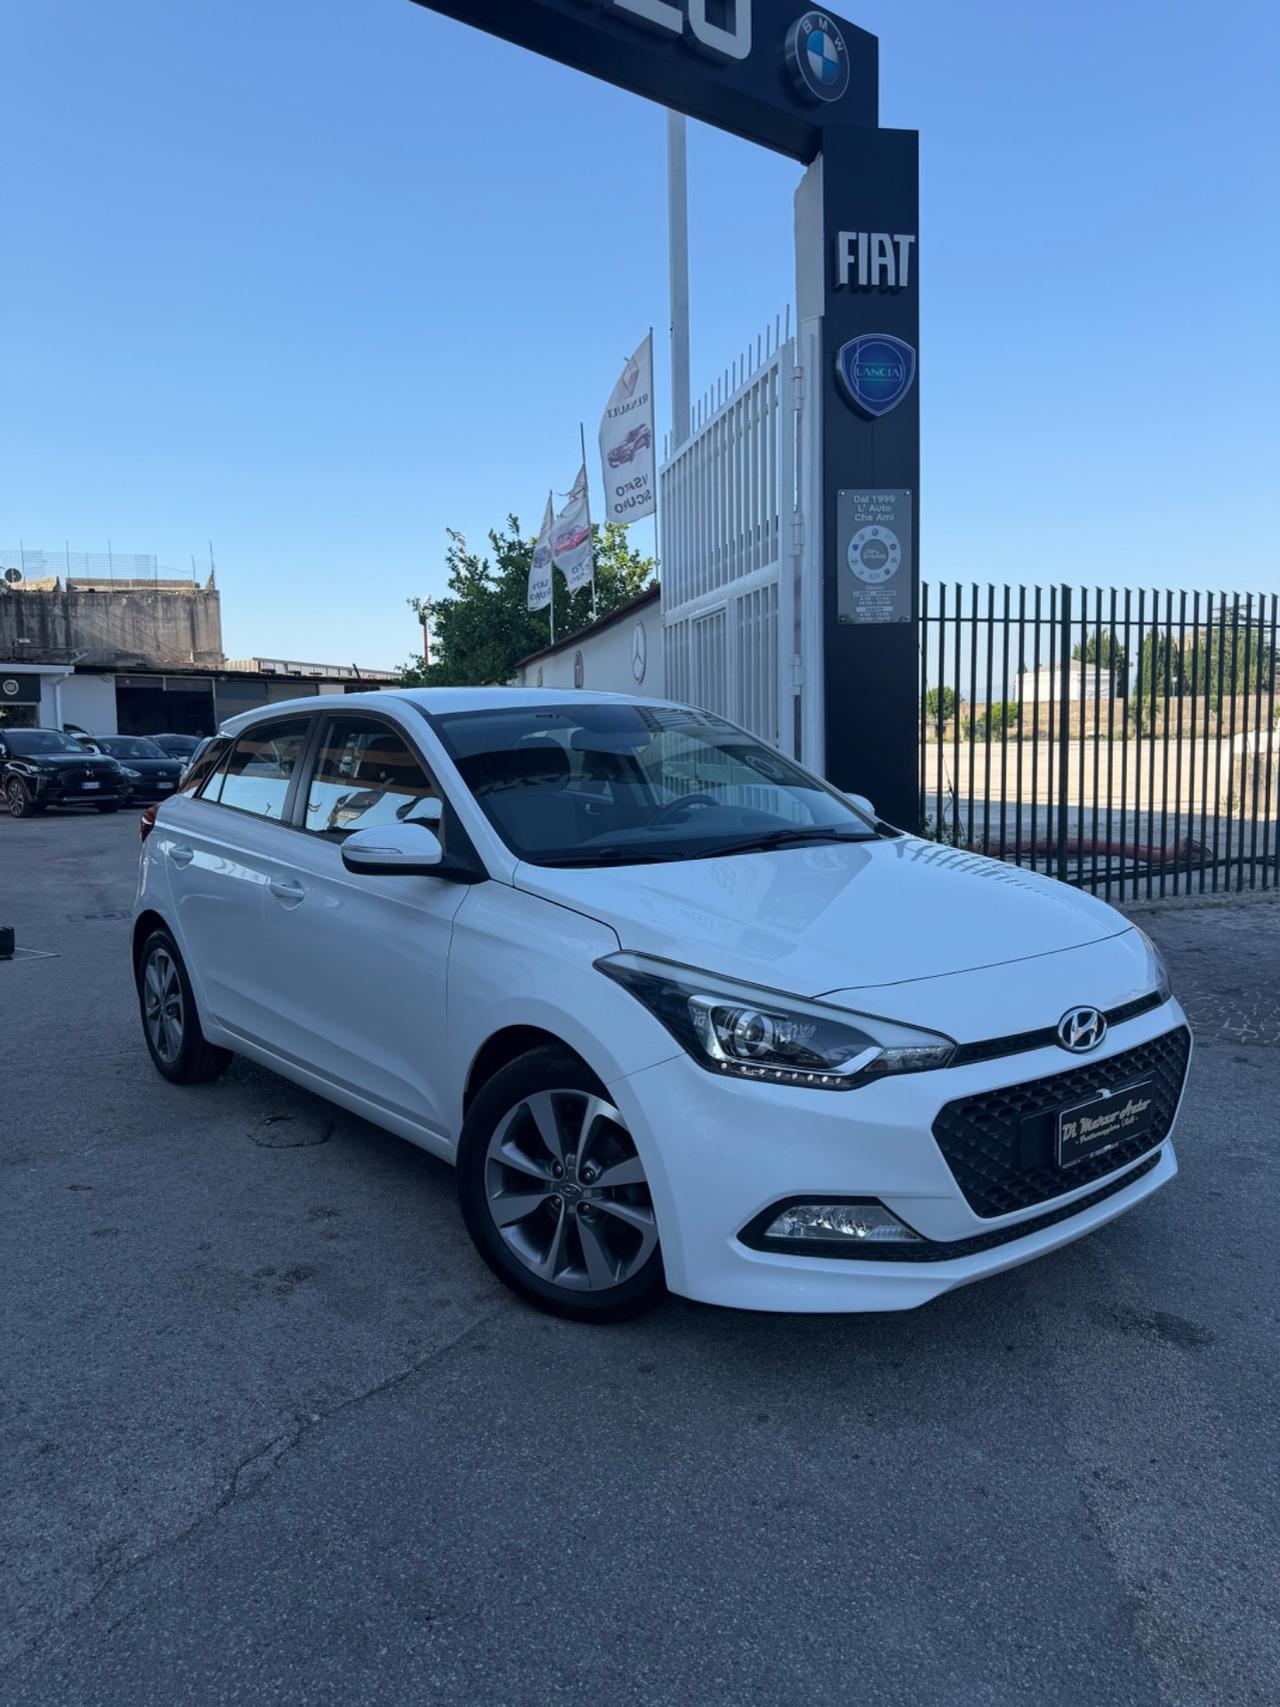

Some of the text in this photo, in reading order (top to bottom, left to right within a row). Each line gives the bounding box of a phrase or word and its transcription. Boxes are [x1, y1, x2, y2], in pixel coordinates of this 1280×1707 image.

[802, 18, 845, 52] BMW
[838, 231, 916, 287] FIAT
[856, 366, 901, 378] LANCIA
[853, 495, 896, 504] Dal 1999
[869, 504, 892, 513] Auto
[854, 512, 895, 522] Che Ami
